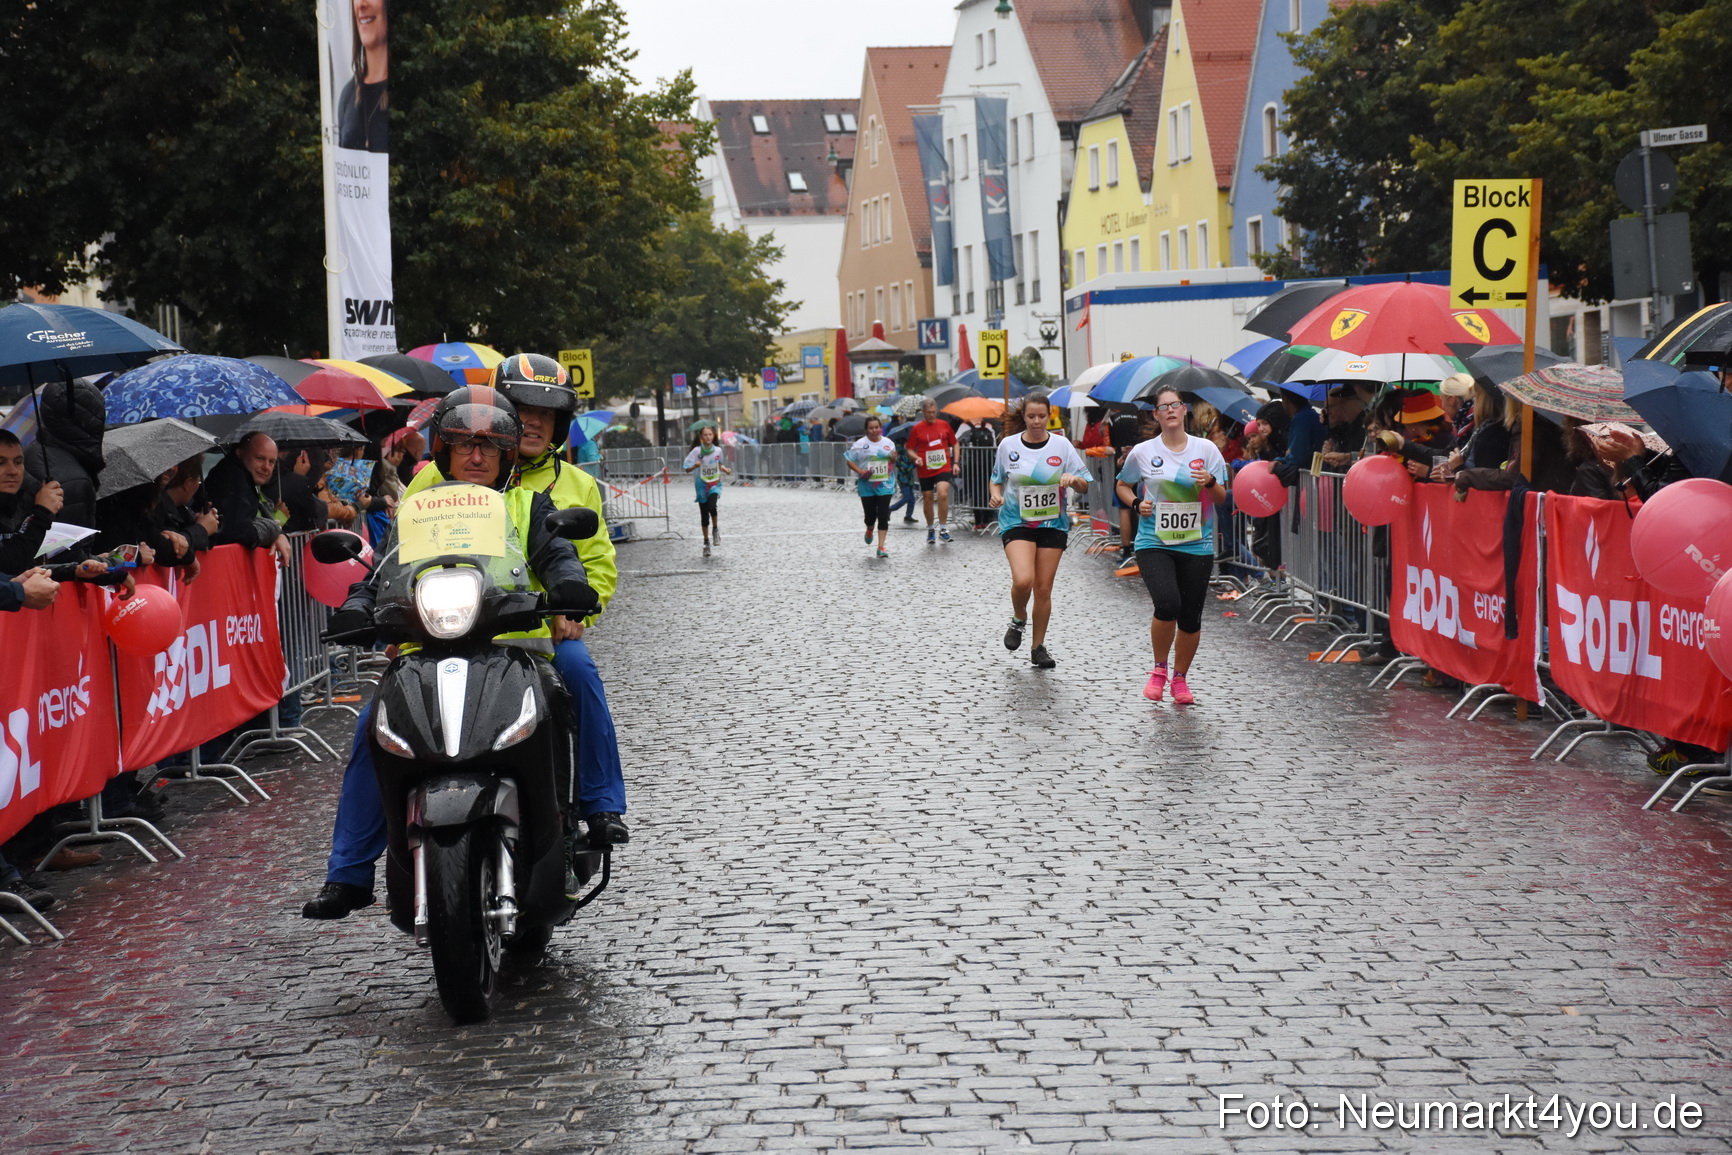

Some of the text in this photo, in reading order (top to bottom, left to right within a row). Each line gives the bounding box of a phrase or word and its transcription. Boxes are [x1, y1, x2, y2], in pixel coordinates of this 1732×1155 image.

[1653, 130, 1704, 143] Ulmer Gasse
[1463, 184, 1531, 208] Block
[1101, 212, 1121, 235] HOTEL
[1472, 217, 1518, 281] C
[38, 330, 87, 342] Fischer
[982, 331, 1005, 341] Block
[562, 352, 588, 362] Block
[986, 345, 1001, 368] D
[568, 364, 585, 387] D
[414, 493, 490, 511] Vorsicht!
[1023, 492, 1057, 509] 5182
[412, 511, 492, 525] Neumarkter Stadtlauf
[1160, 512, 1198, 530] 5067
[1172, 531, 1186, 540] Lisa
